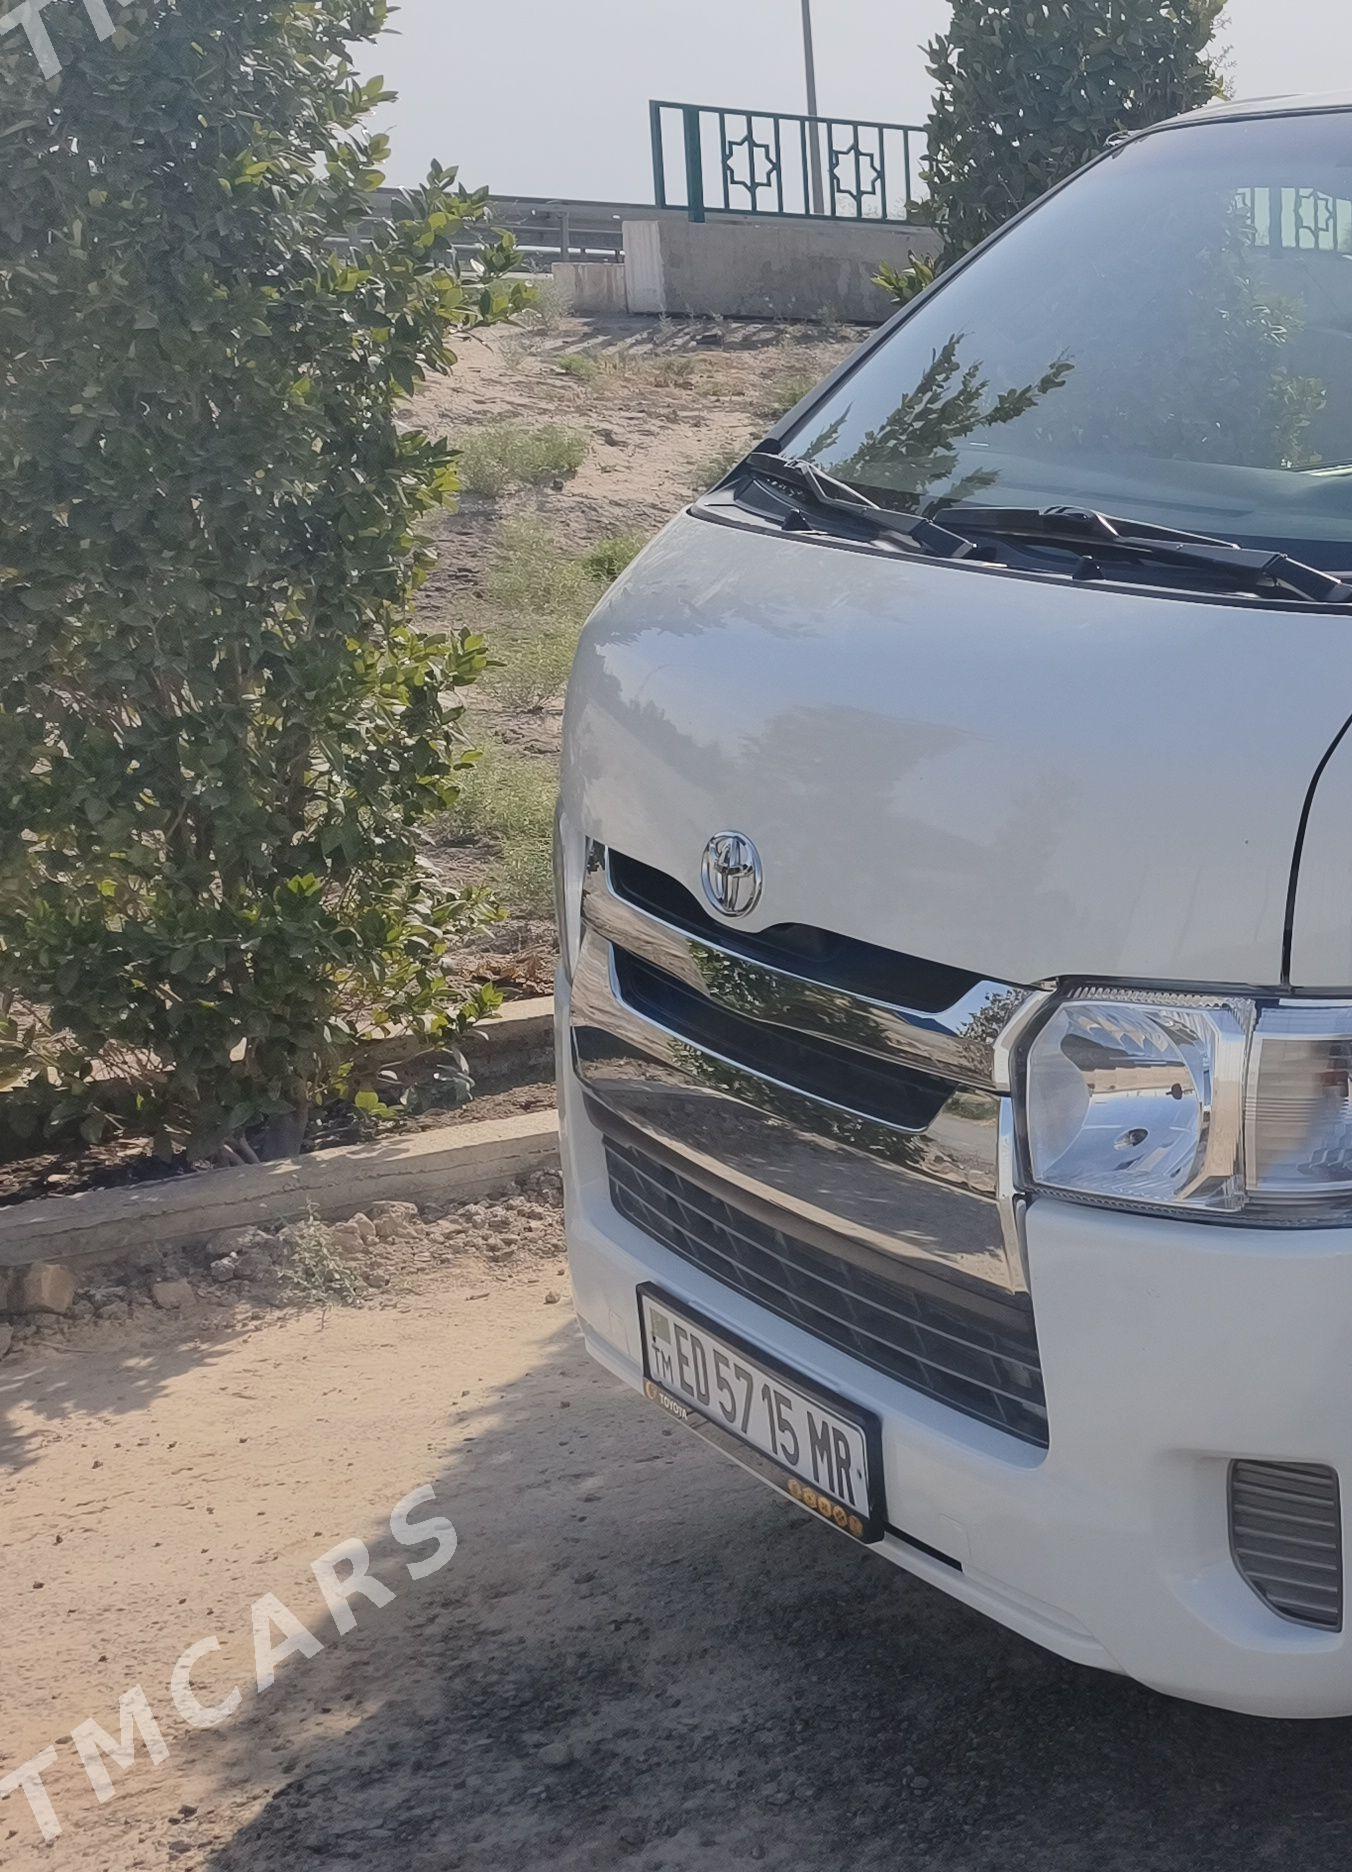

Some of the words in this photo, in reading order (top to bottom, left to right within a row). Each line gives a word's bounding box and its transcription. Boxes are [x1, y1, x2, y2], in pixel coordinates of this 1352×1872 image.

[652, 1344, 674, 1385] TM
[674, 1323, 711, 1407] ED
[807, 1411, 856, 1507] MR
[659, 1392, 689, 1421] TOYOTA
